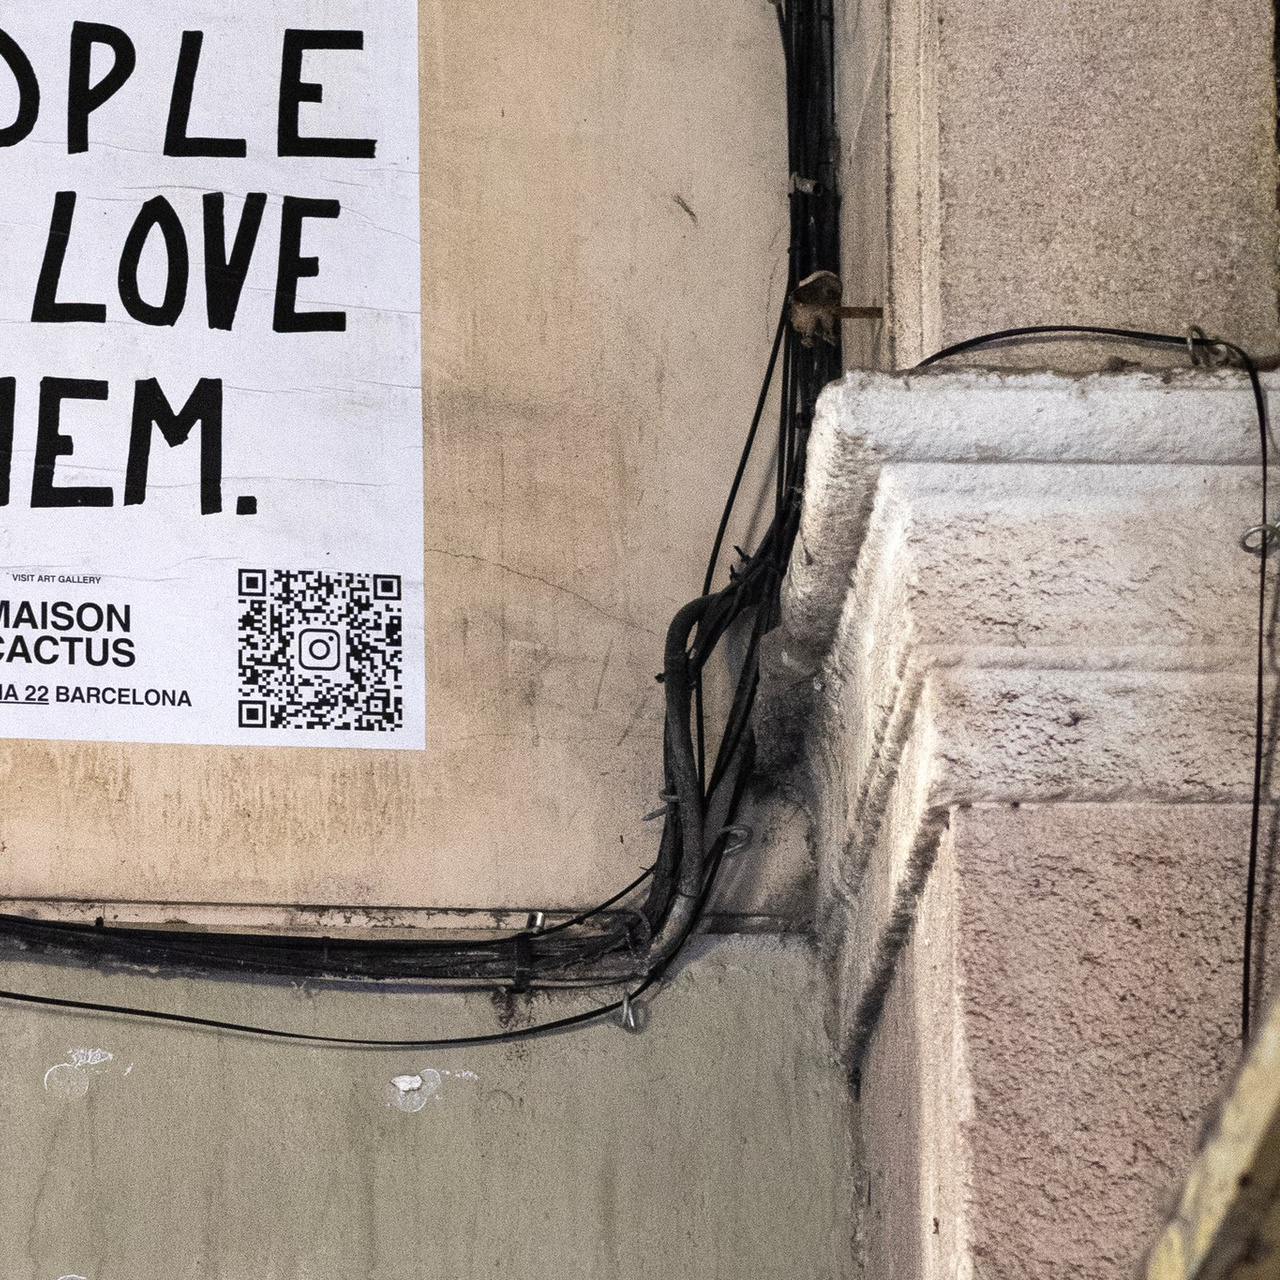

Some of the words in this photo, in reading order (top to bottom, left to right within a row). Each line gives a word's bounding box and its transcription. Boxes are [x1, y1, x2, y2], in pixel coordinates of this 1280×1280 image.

[31, 191, 346, 333] LOVE
[12, 573, 35, 582] VISIT
[37, 574, 56, 583] ART
[58, 575, 101, 584] GALLERY
[24, 685, 49, 702] 22
[55, 686, 192, 707] BARCELONA
